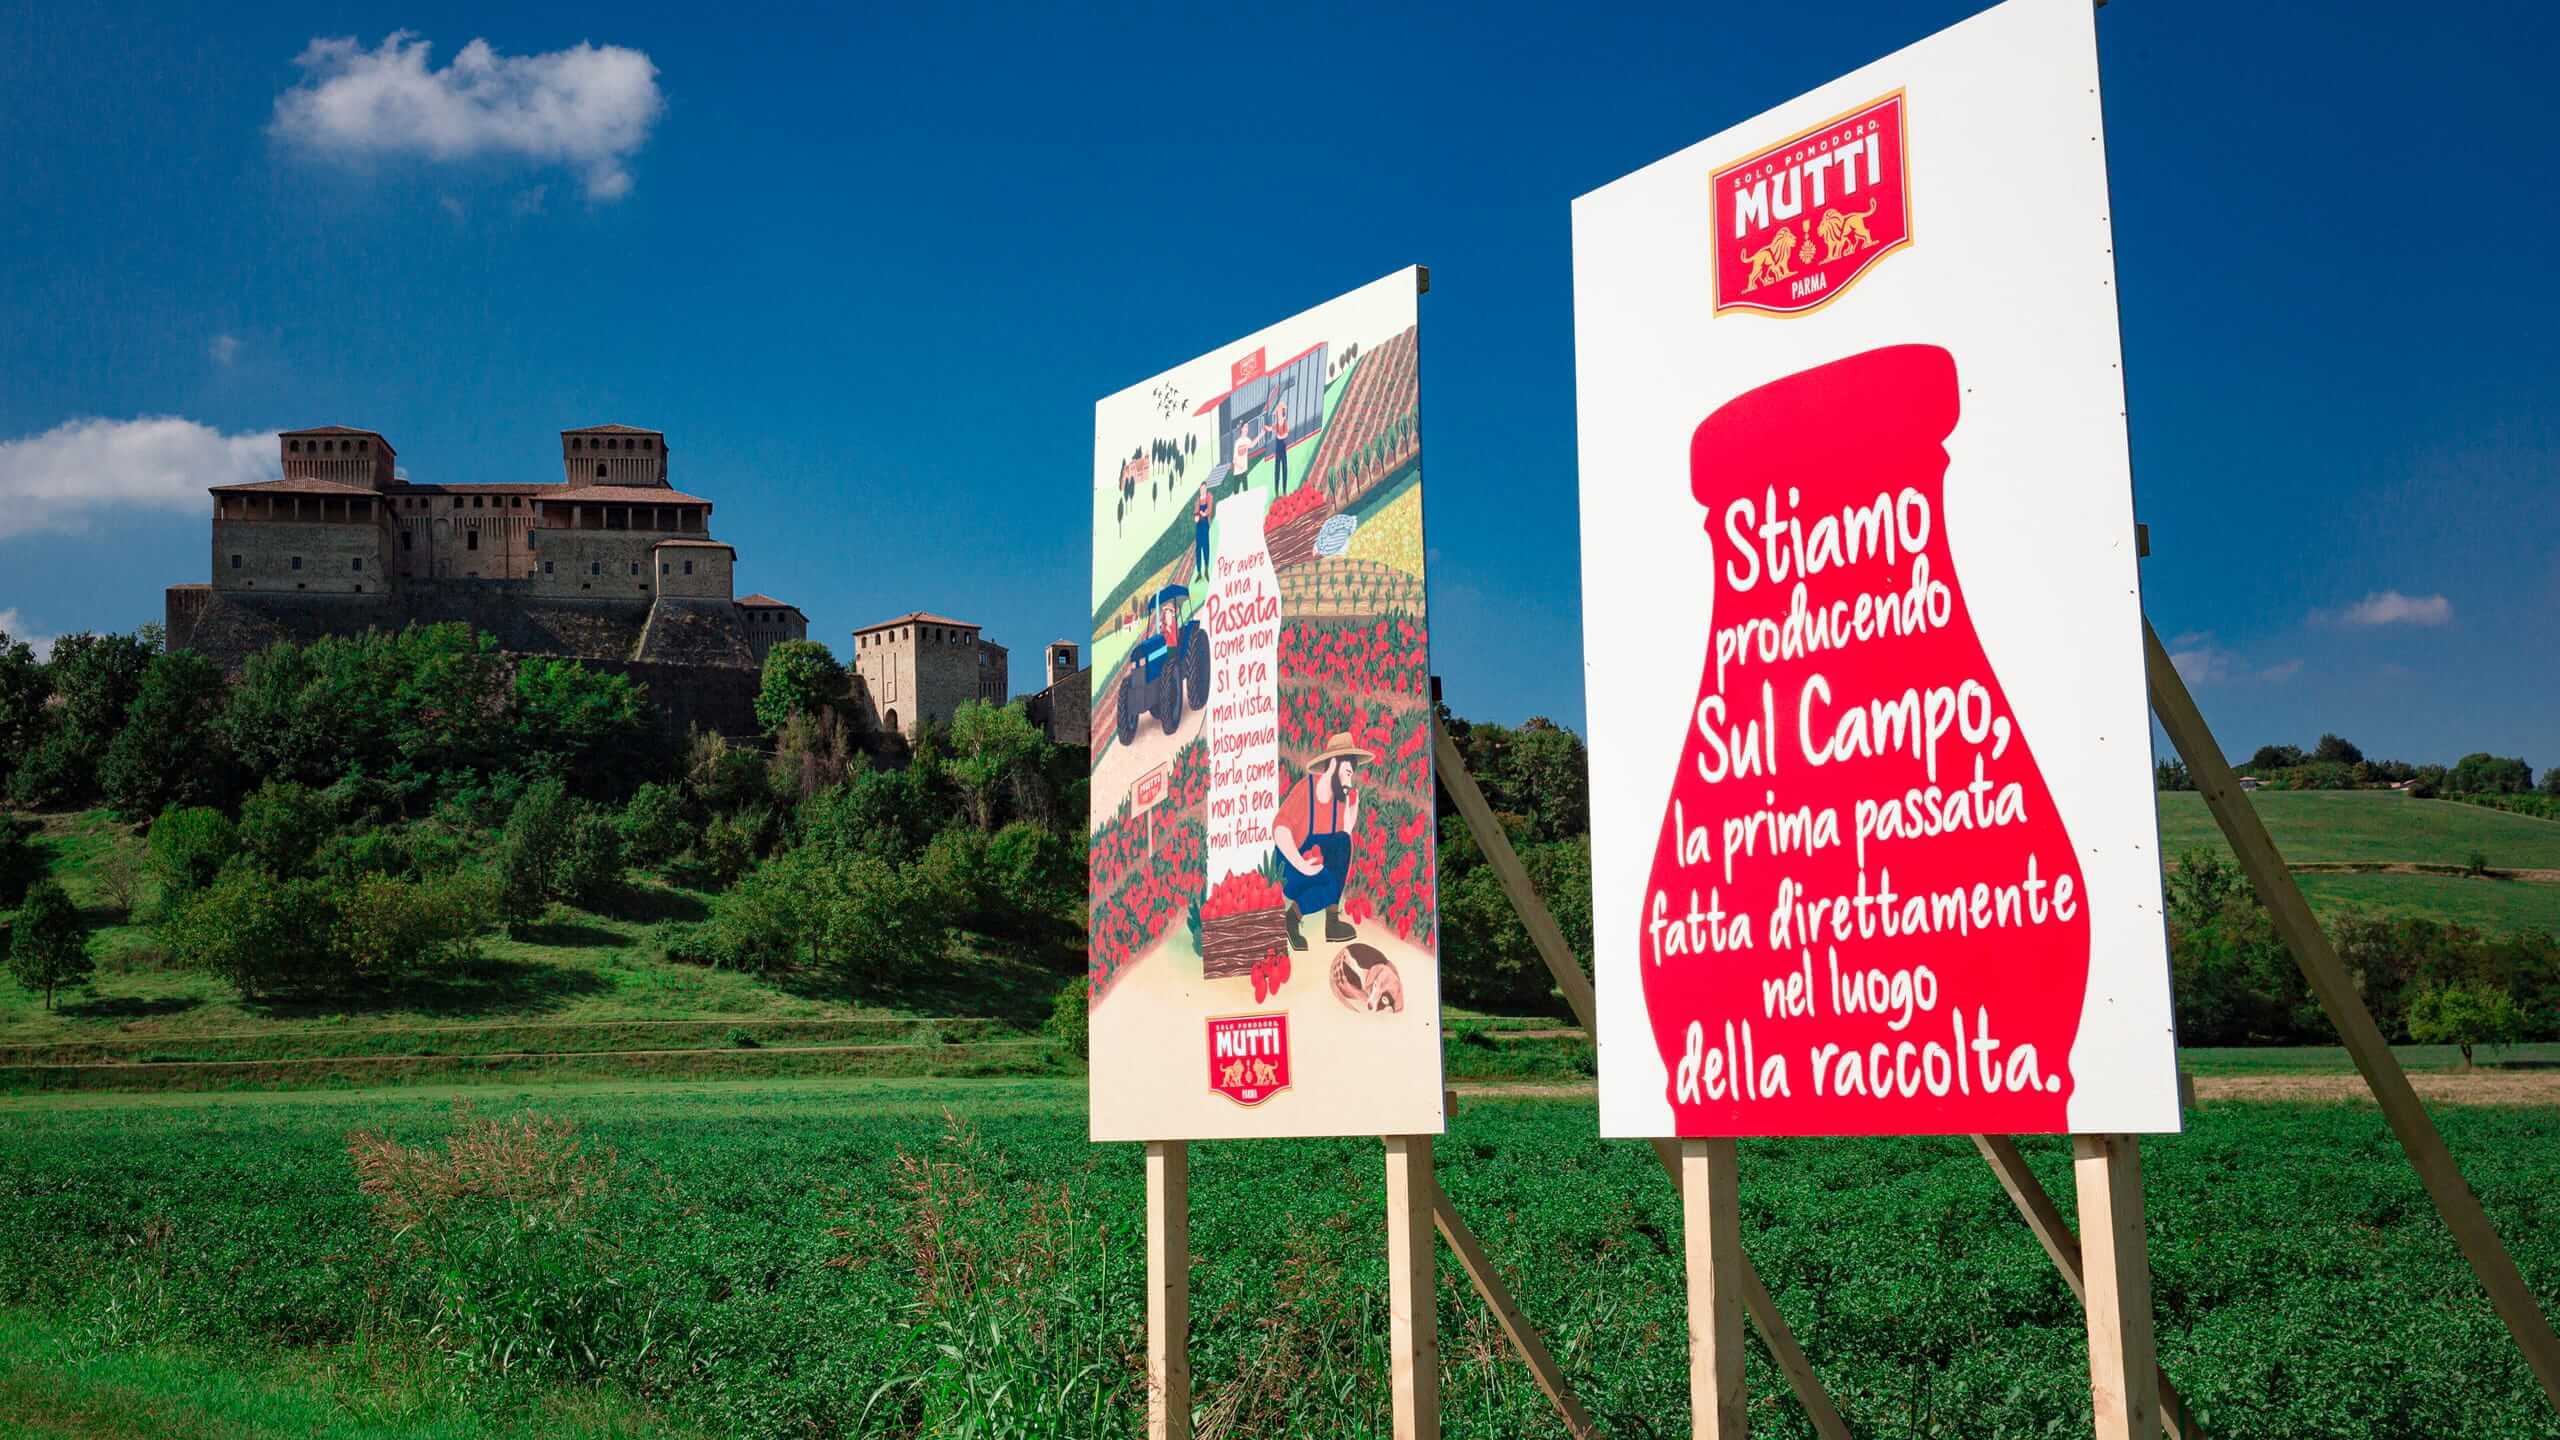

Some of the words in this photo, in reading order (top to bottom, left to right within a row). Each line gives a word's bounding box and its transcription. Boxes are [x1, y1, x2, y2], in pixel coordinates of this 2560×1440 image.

[1734, 164, 1773, 189] SOLO
[1735, 132, 1881, 239] MUTTI
[1791, 272, 1827, 300] PARMA
[1725, 484, 1930, 592] Stiamo
[1217, 556, 1235, 578] Per
[1237, 551, 1265, 573] avere
[1225, 577, 1251, 598] una
[1206, 581, 1279, 638] Passata
[1717, 553, 1951, 693] producendo
[1214, 633, 1244, 660] come
[1250, 629, 1273, 650] non
[1217, 659, 1230, 693] si
[1238, 661, 1267, 687] era
[1212, 693, 1237, 722] mai
[1213, 727, 1276, 759] bisognava
[1697, 679, 1776, 783] Sul
[1799, 673, 2010, 783] Campo,
[1213, 759, 1243, 792] farla
[1246, 760, 1275, 783] come
[1211, 796, 1235, 819] non
[1238, 784, 1249, 815] si
[1252, 790, 1274, 812] era
[1675, 798, 1710, 867] la
[1724, 790, 1840, 884] prima
[1856, 752, 2027, 868] passata
[1210, 823, 1232, 849] mai
[1234, 816, 1272, 848] fatta.
[1649, 886, 1752, 966] fatta
[1770, 852, 2077, 951] direttamente
[1763, 946, 1815, 1018] nel
[1829, 944, 1937, 1031] luogo
[1216, 1027, 1279, 1057] MUTTI
[1677, 1017, 1791, 1105] della
[1811, 1004, 2061, 1098] raccolta.
